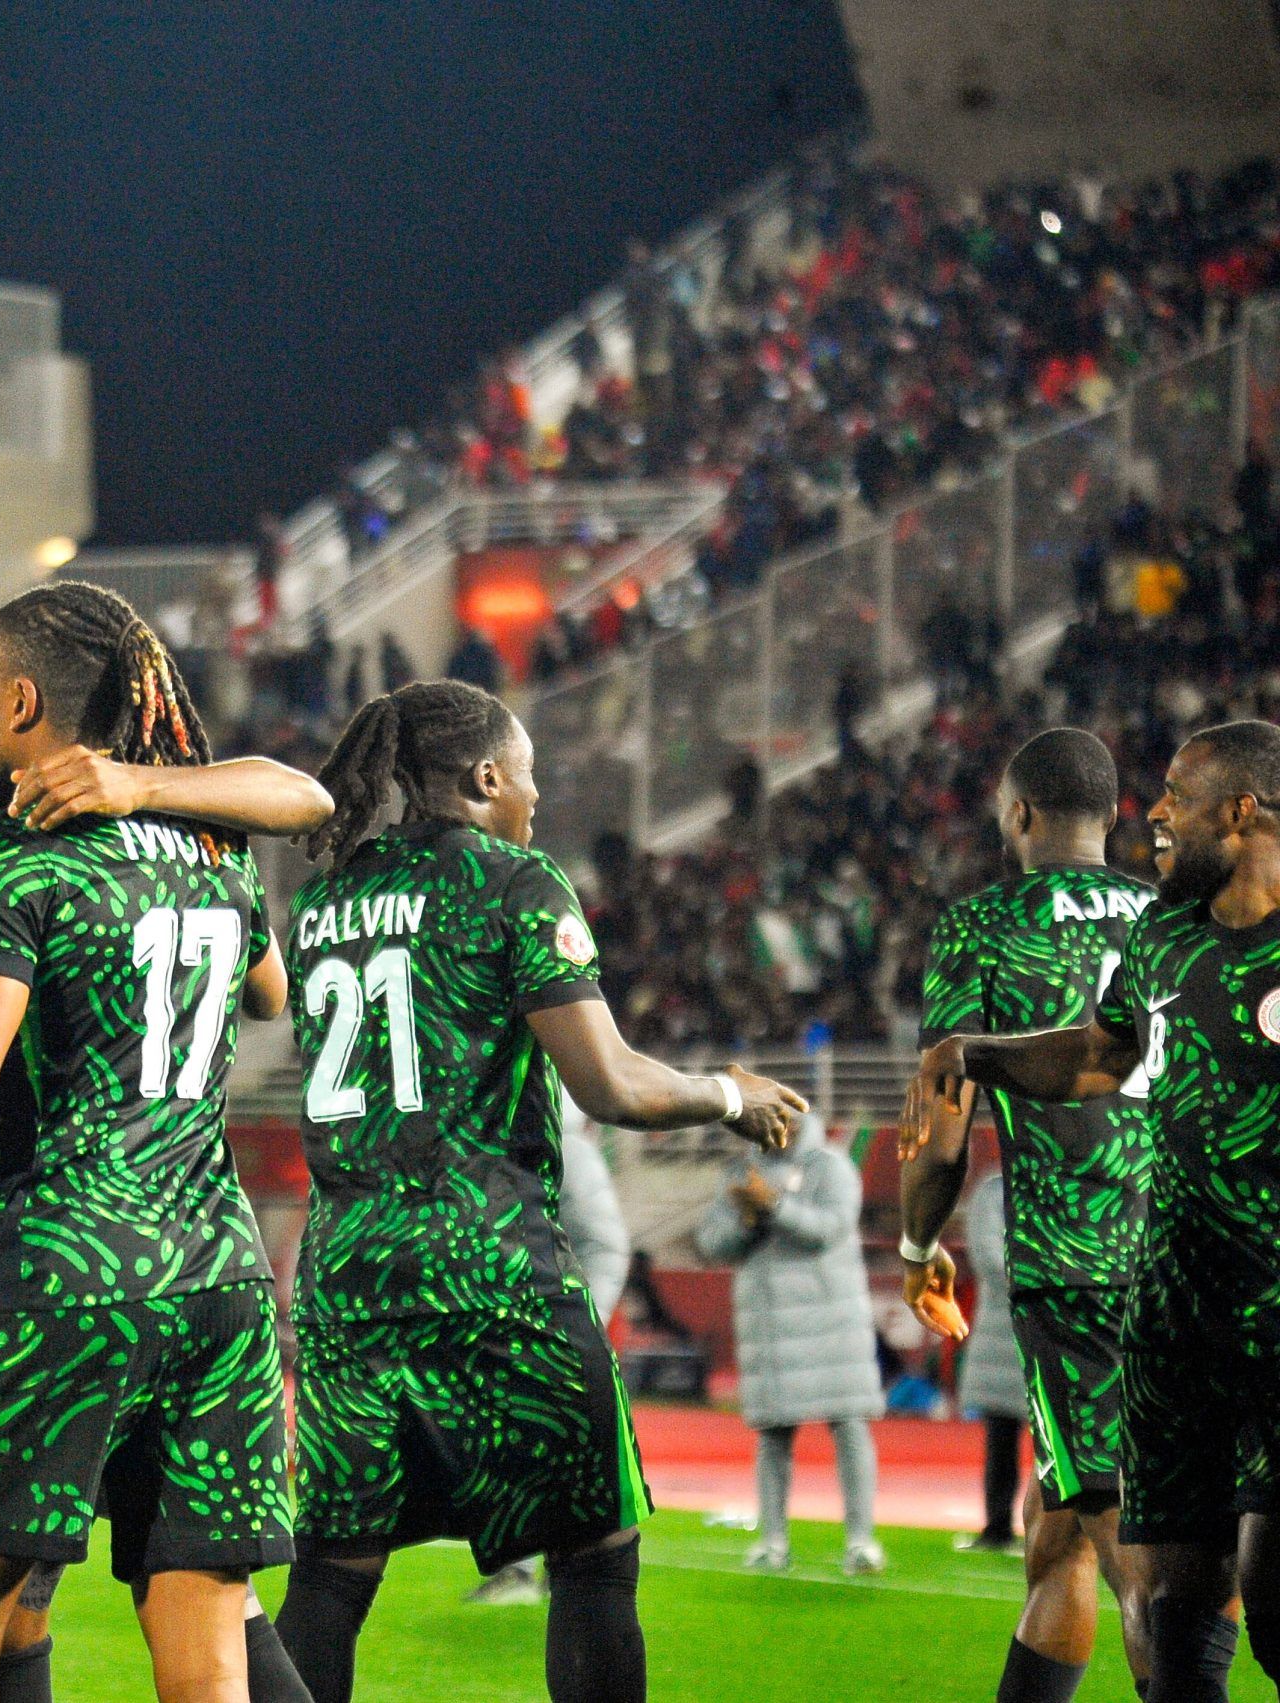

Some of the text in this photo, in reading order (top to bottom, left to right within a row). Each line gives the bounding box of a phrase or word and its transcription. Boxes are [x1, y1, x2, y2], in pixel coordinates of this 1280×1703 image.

[299, 895, 427, 950] CALVIN
[1053, 888, 1158, 921] AJAY
[132, 907, 241, 1100] 17
[305, 948, 424, 1124] 21
